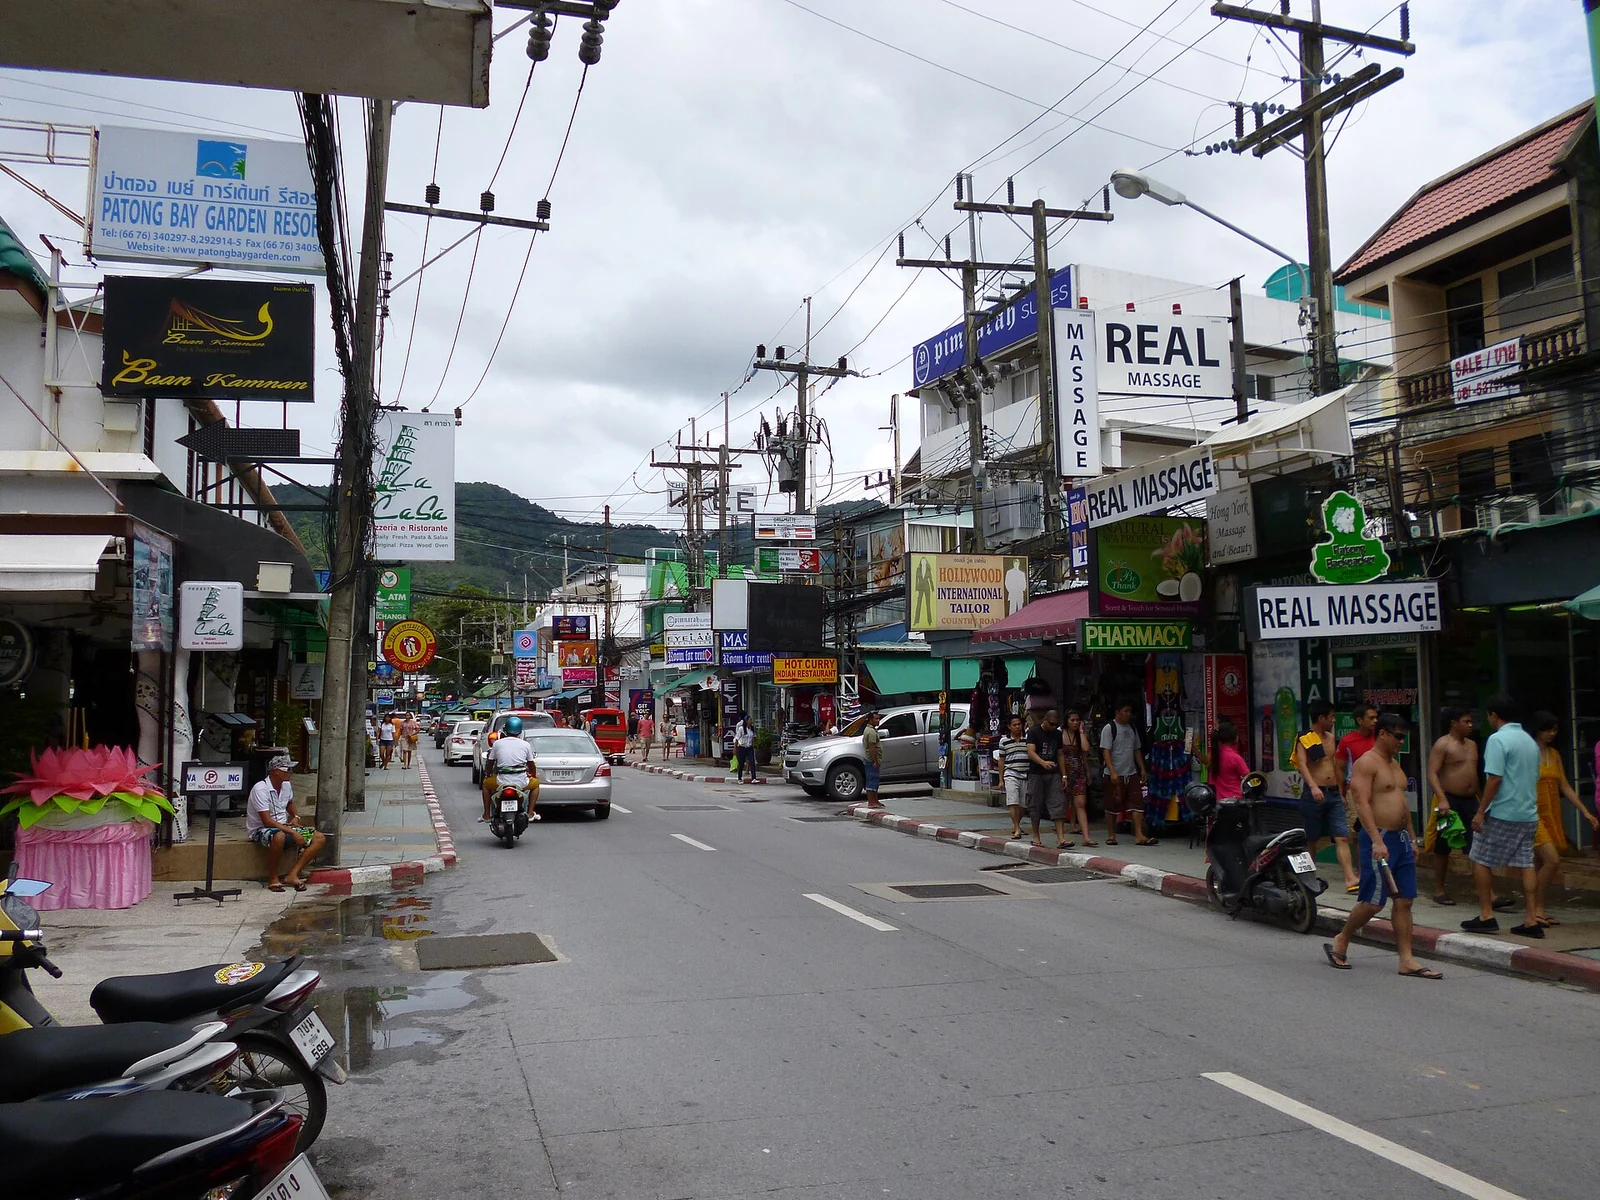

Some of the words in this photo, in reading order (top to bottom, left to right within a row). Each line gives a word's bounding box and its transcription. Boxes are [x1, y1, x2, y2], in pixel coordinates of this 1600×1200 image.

[278, 187, 318, 206] รีสอร
[101, 197, 163, 226] PATONG
[170, 202, 199, 229] BAY
[205, 205, 267, 234] GARDEN
[274, 210, 318, 238] RESOR
[101, 228, 117, 238] Tel:
[119, 229, 134, 240] (66
[136, 230, 151, 241] 76)
[245, 239, 261, 249] Fax
[263, 240, 277, 250] (66
[279, 240, 293, 251] 76)
[127, 241, 166, 253] Website
[1105, 323, 1220, 367] REAL
[111, 349, 191, 387] Baan
[203, 373, 308, 390] Kamnan
[1455, 354, 1482, 378] SALE
[1127, 372, 1201, 388] MASSAGE
[1067, 323, 1088, 469] MASSAGE
[1087, 484, 1129, 522] REAL
[1132, 456, 1213, 509] MASSAGE
[408, 524, 448, 532] Ristorante
[1103, 522, 1168, 535] NATURAL
[1216, 525, 1247, 539] Massage
[1212, 544, 1227, 559] and
[1227, 542, 1252, 557] Beauty
[939, 567, 1002, 583] HOLLYWOOD
[388, 593, 407, 601] ATM
[937, 587, 1003, 600] INTERNATIONAL
[950, 603, 990, 613] TAILOR
[1259, 596, 1320, 630] REAL
[1328, 592, 1438, 626] MASSAGE
[941, 617, 976, 625] COUNTRY
[723, 632, 747, 647] MAS
[1086, 625, 1187, 647] PHARMACY
[668, 651, 685, 662] Room
[685, 650, 694, 661] for
[694, 650, 706, 661] rent
[722, 652, 743, 665] Room
[744, 653, 755, 664] for
[756, 653, 771, 663] rent
[784, 659, 804, 669] HOT
[804, 659, 835, 669] CURRY
[775, 670, 797, 678] INDIAN
[797, 669, 837, 678] RESTAURANT
[1307, 637, 1322, 704] PHA
[1363, 688, 1418, 705] PHARMACY
[311, 1039, 331, 1061] 599
